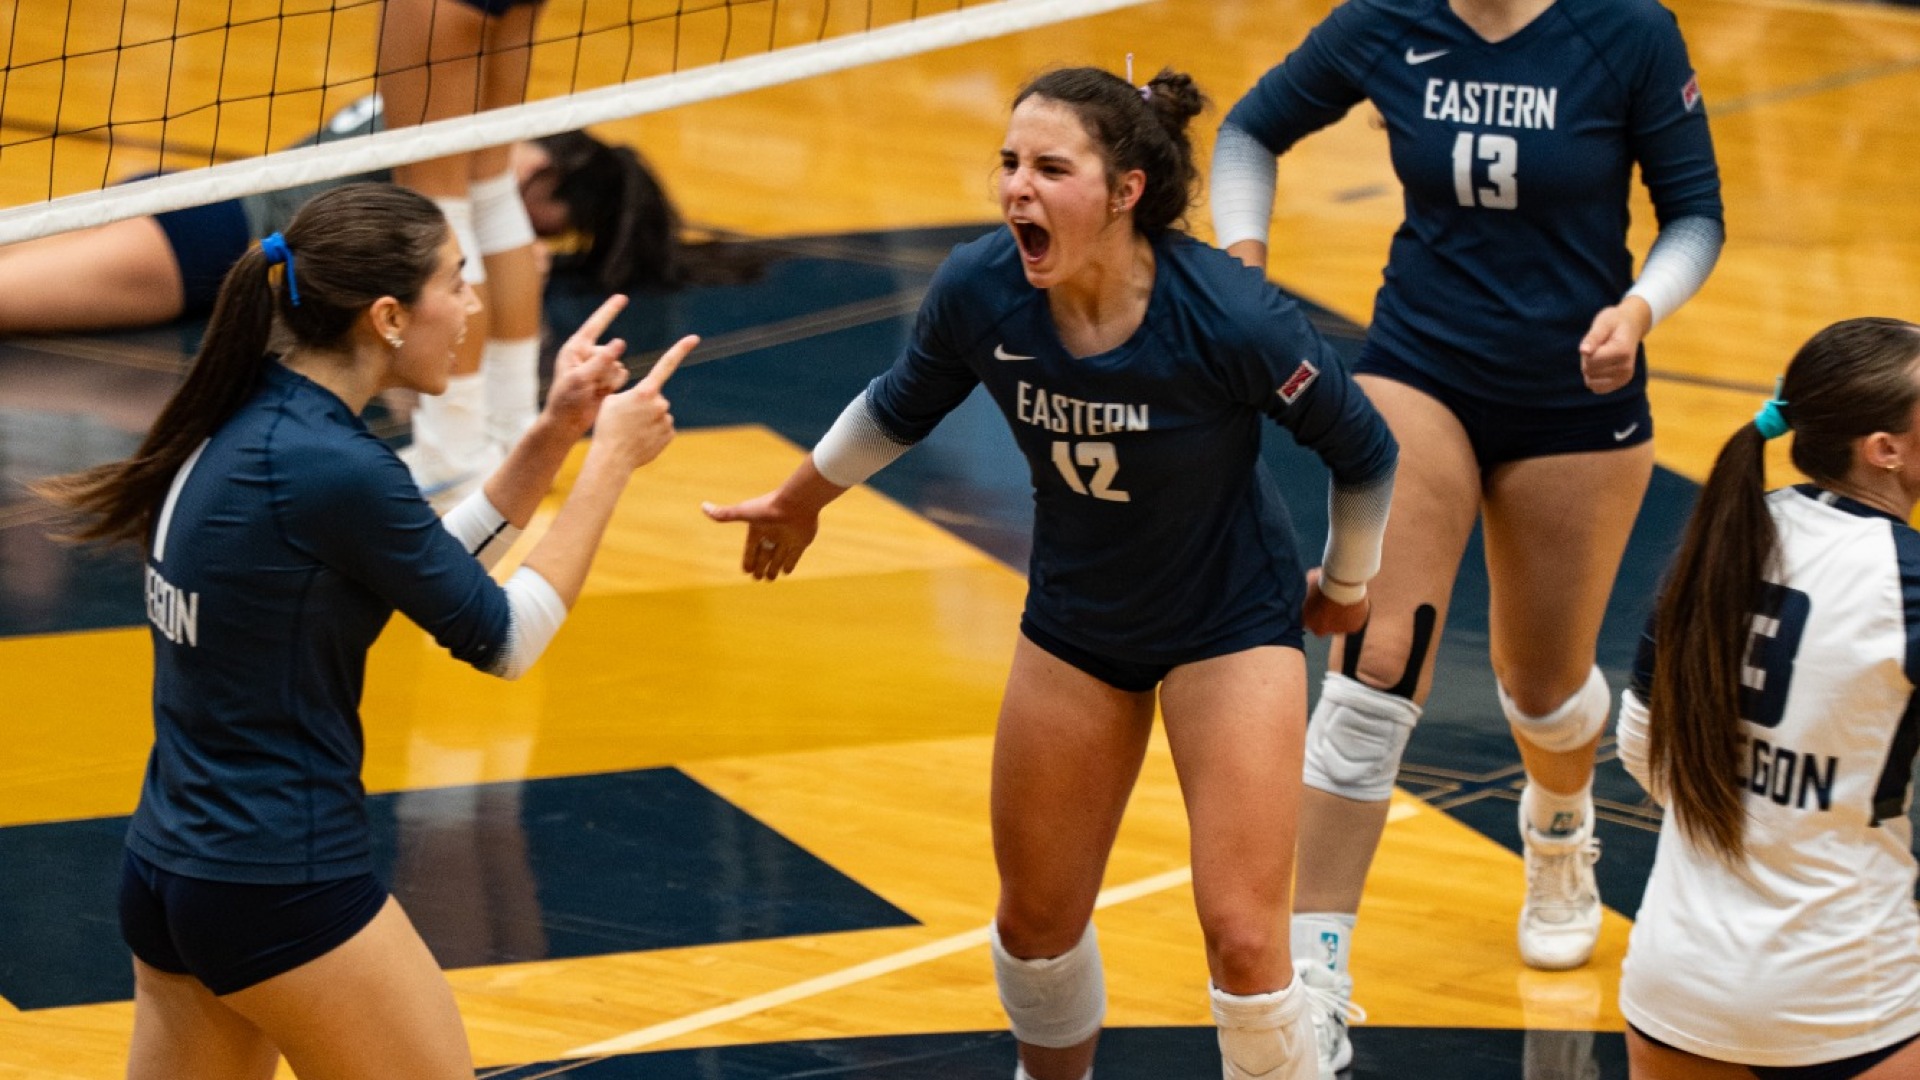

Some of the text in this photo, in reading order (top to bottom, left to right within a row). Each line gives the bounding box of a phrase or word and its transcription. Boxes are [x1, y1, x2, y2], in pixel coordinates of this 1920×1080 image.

[1423, 78, 1557, 130] EASTERN
[1452, 131, 1518, 209] 13
[1017, 381, 1149, 435] EASTERN
[1052, 441, 1131, 502] 12
